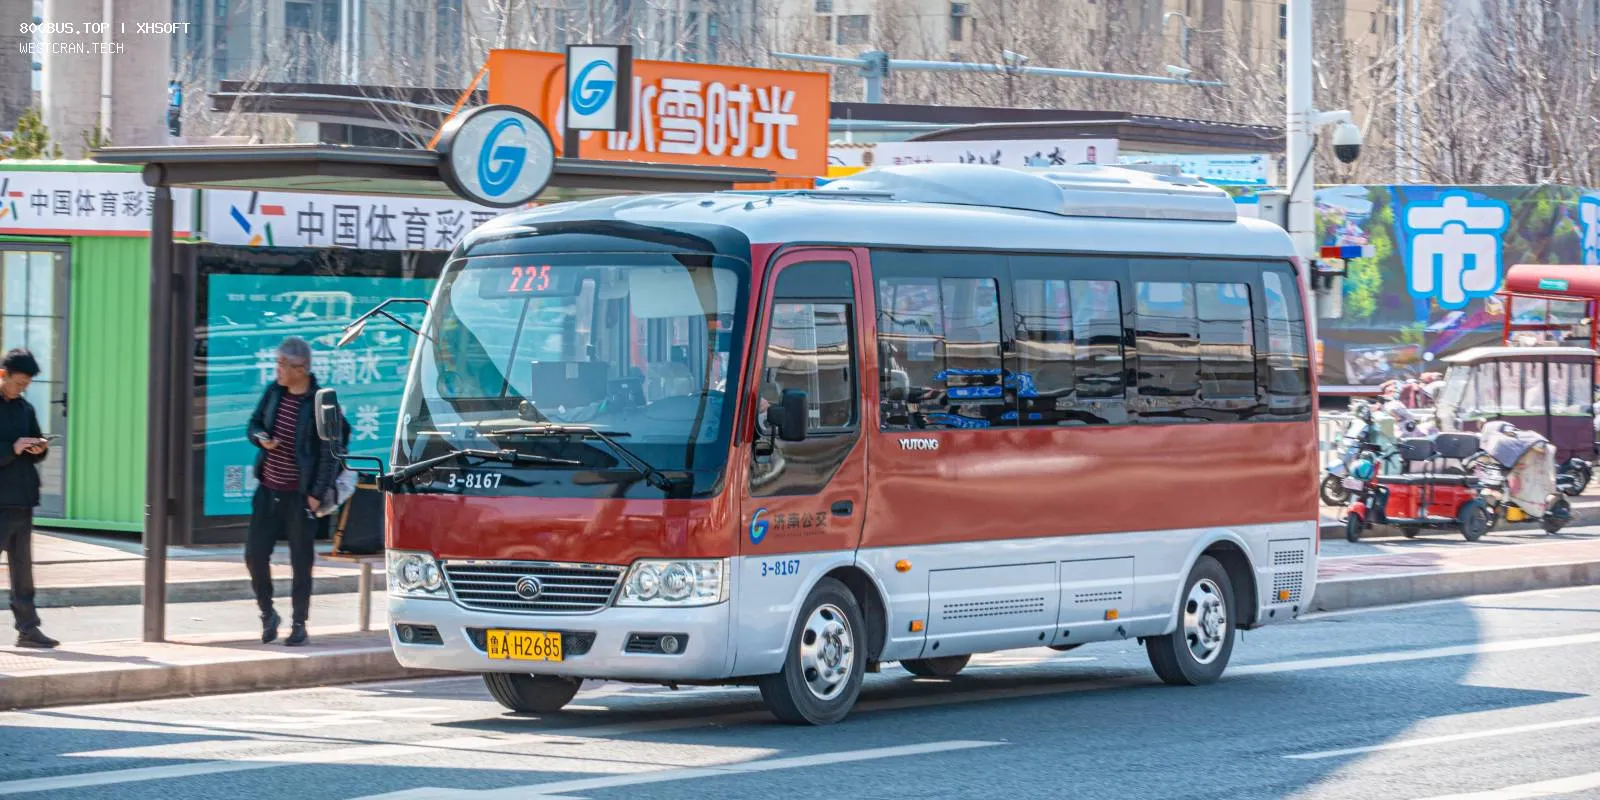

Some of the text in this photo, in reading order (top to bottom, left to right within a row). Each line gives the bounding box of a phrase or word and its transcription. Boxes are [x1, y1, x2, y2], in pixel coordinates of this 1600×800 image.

[1407, 194, 1506, 304] 市
[508, 265, 551, 292] 225
[254, 348, 381, 385] 节每滴水
[899, 438, 939, 450] YUTONG
[447, 473, 502, 488] 3-8167
[761, 560, 800, 576] 3-8167
